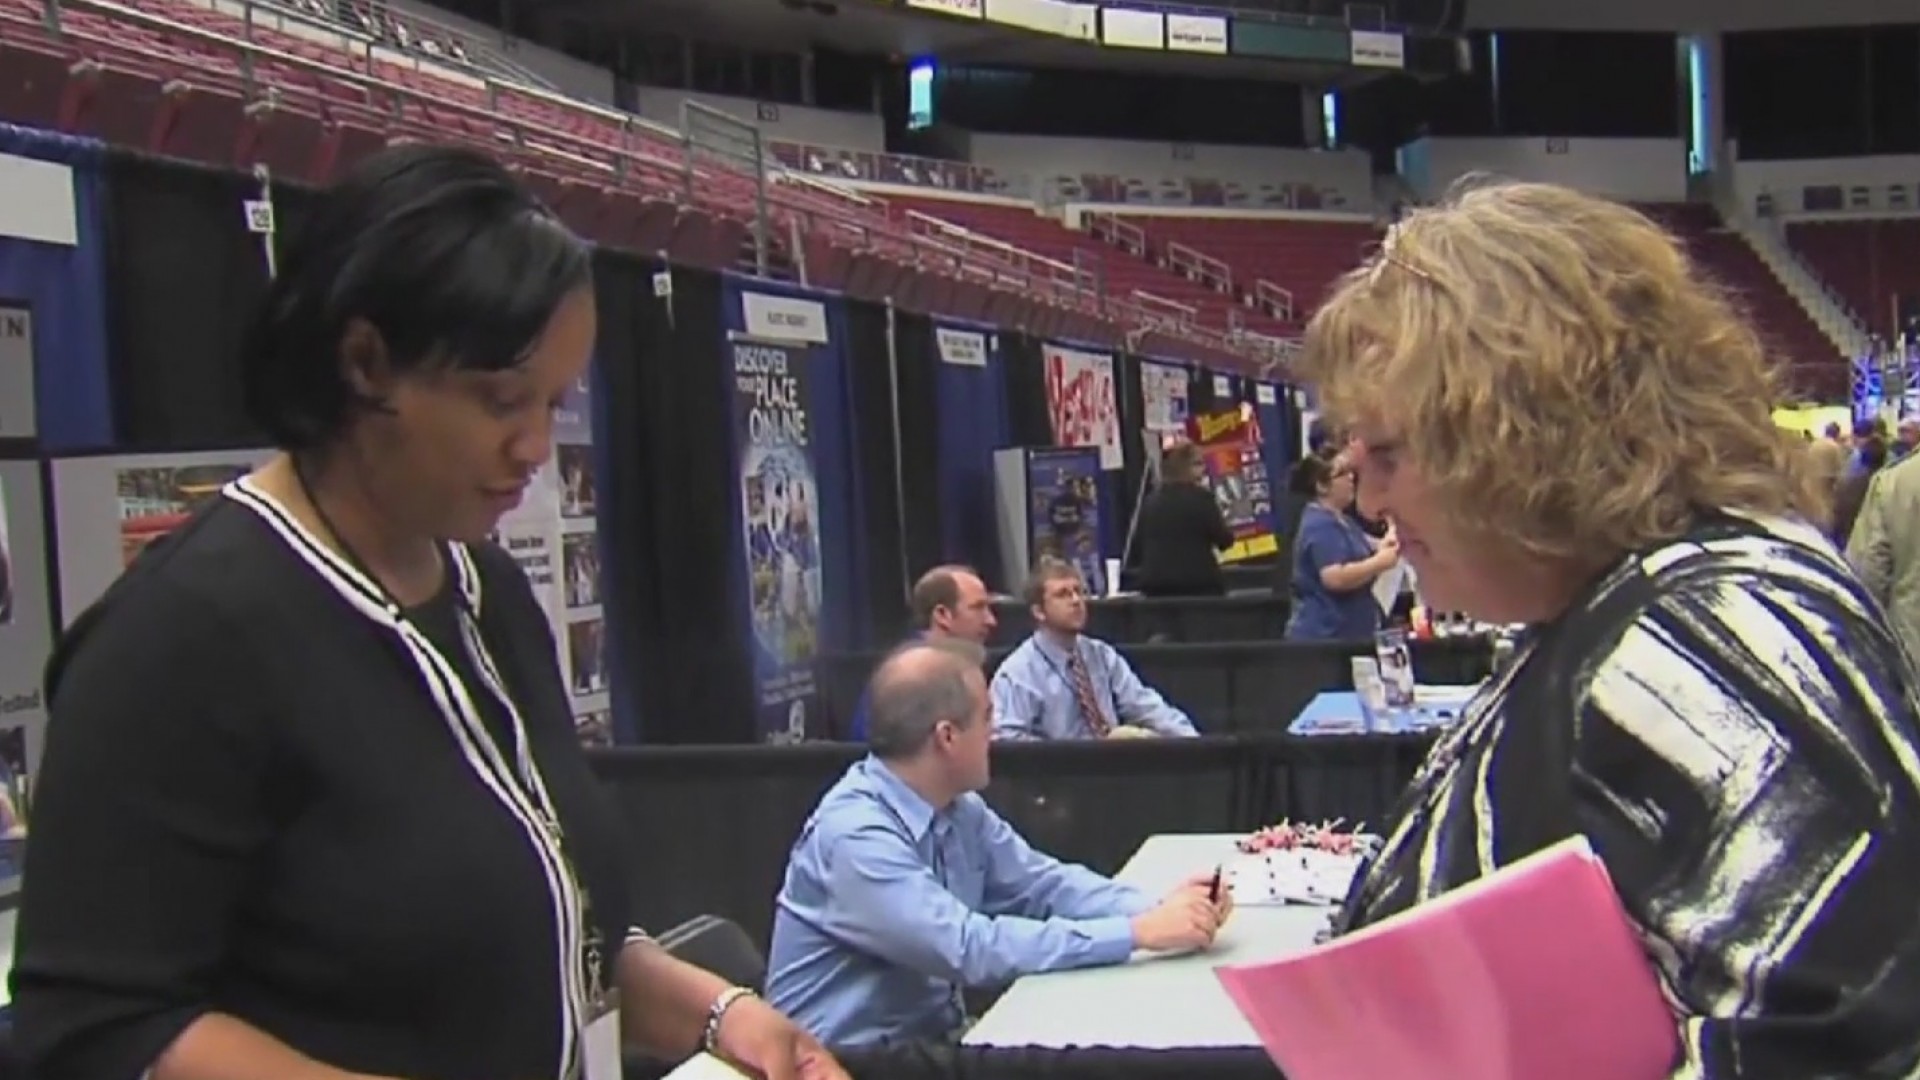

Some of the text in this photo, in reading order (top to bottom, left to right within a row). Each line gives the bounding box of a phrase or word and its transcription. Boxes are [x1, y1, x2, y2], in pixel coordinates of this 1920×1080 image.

[734, 347, 788, 374] DISCOVER
[756, 376, 798, 408] PLACE
[750, 408, 807, 446] ONLINE
